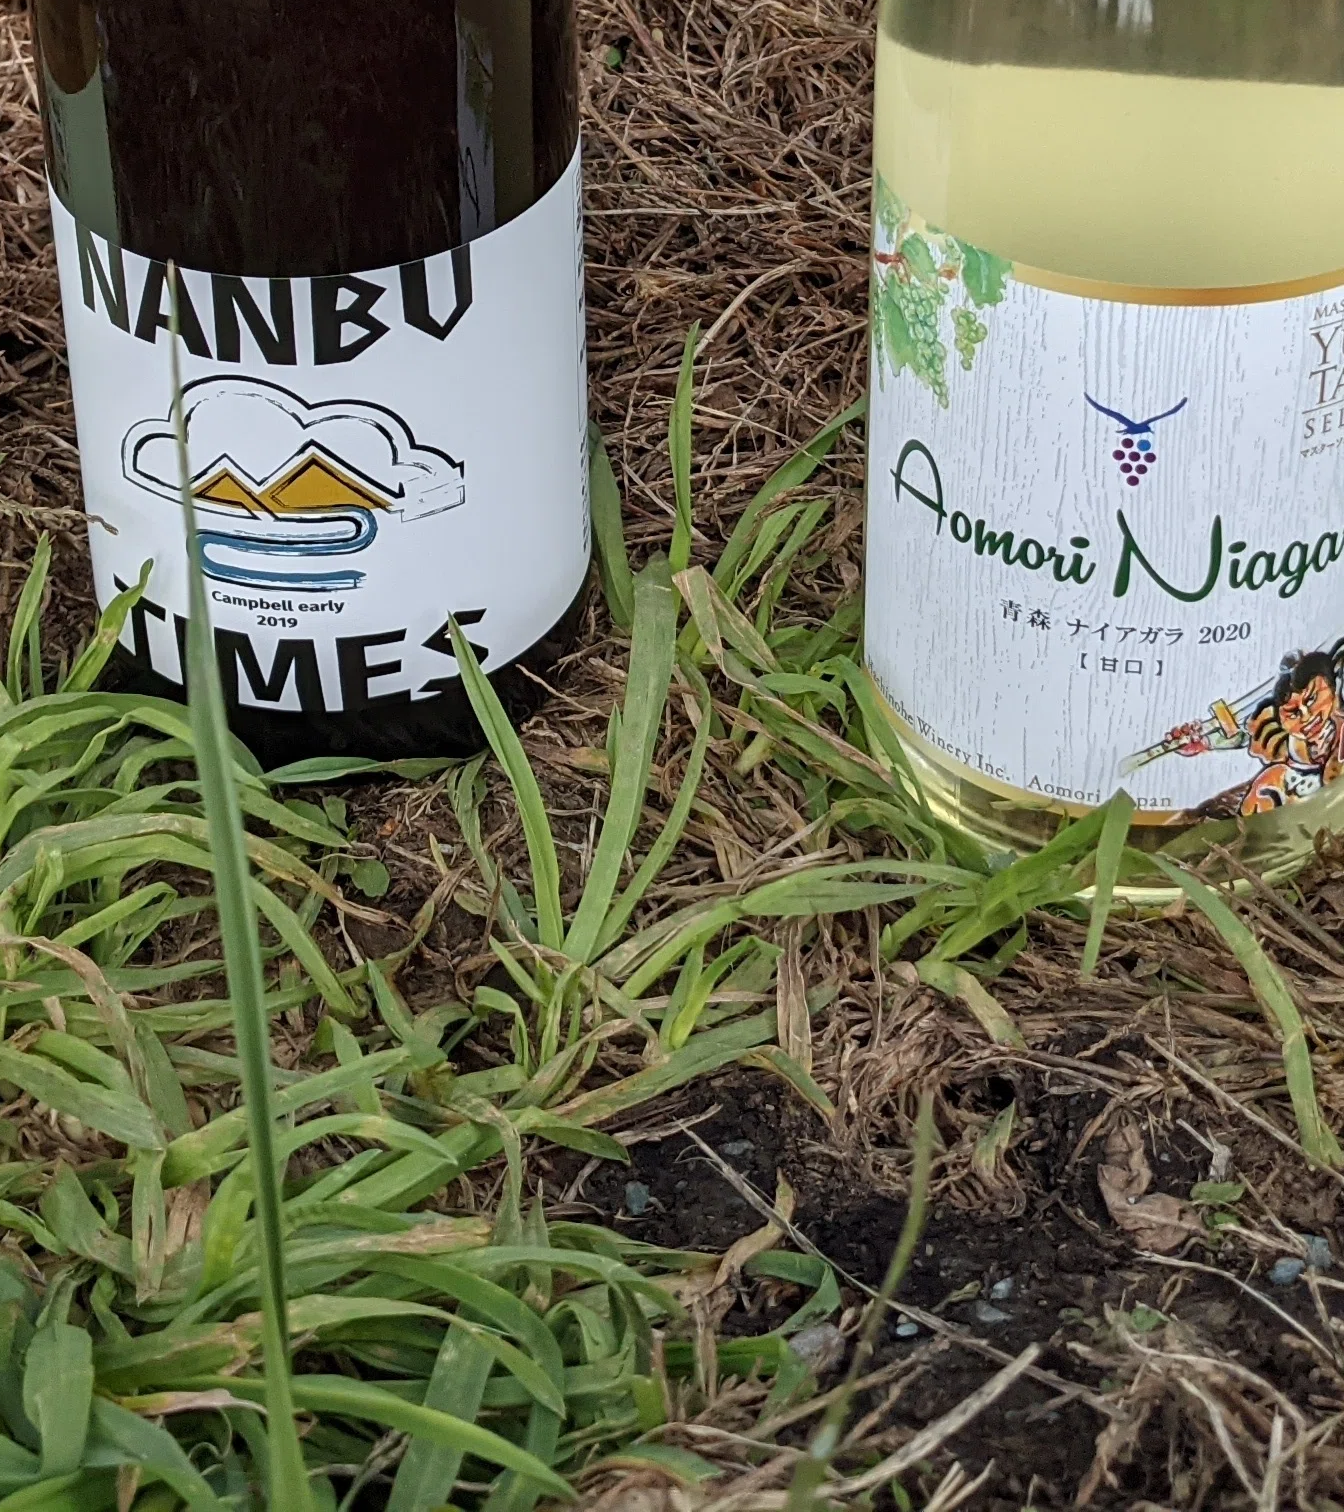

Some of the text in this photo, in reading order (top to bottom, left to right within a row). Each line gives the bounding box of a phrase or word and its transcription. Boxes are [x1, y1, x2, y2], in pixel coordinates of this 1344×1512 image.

[74, 219, 472, 366] NANBU
[889, 438, 1097, 586] Aomori
[211, 590, 345, 615] Campbell early
[256, 614, 298, 629] 2019
[999, 598, 1252, 646] 青森 ナイアガラ 2020
[916, 715, 972, 765] Winery
[975, 752, 1011, 782] Inc.
[1028, 775, 1101, 804] Aomori
